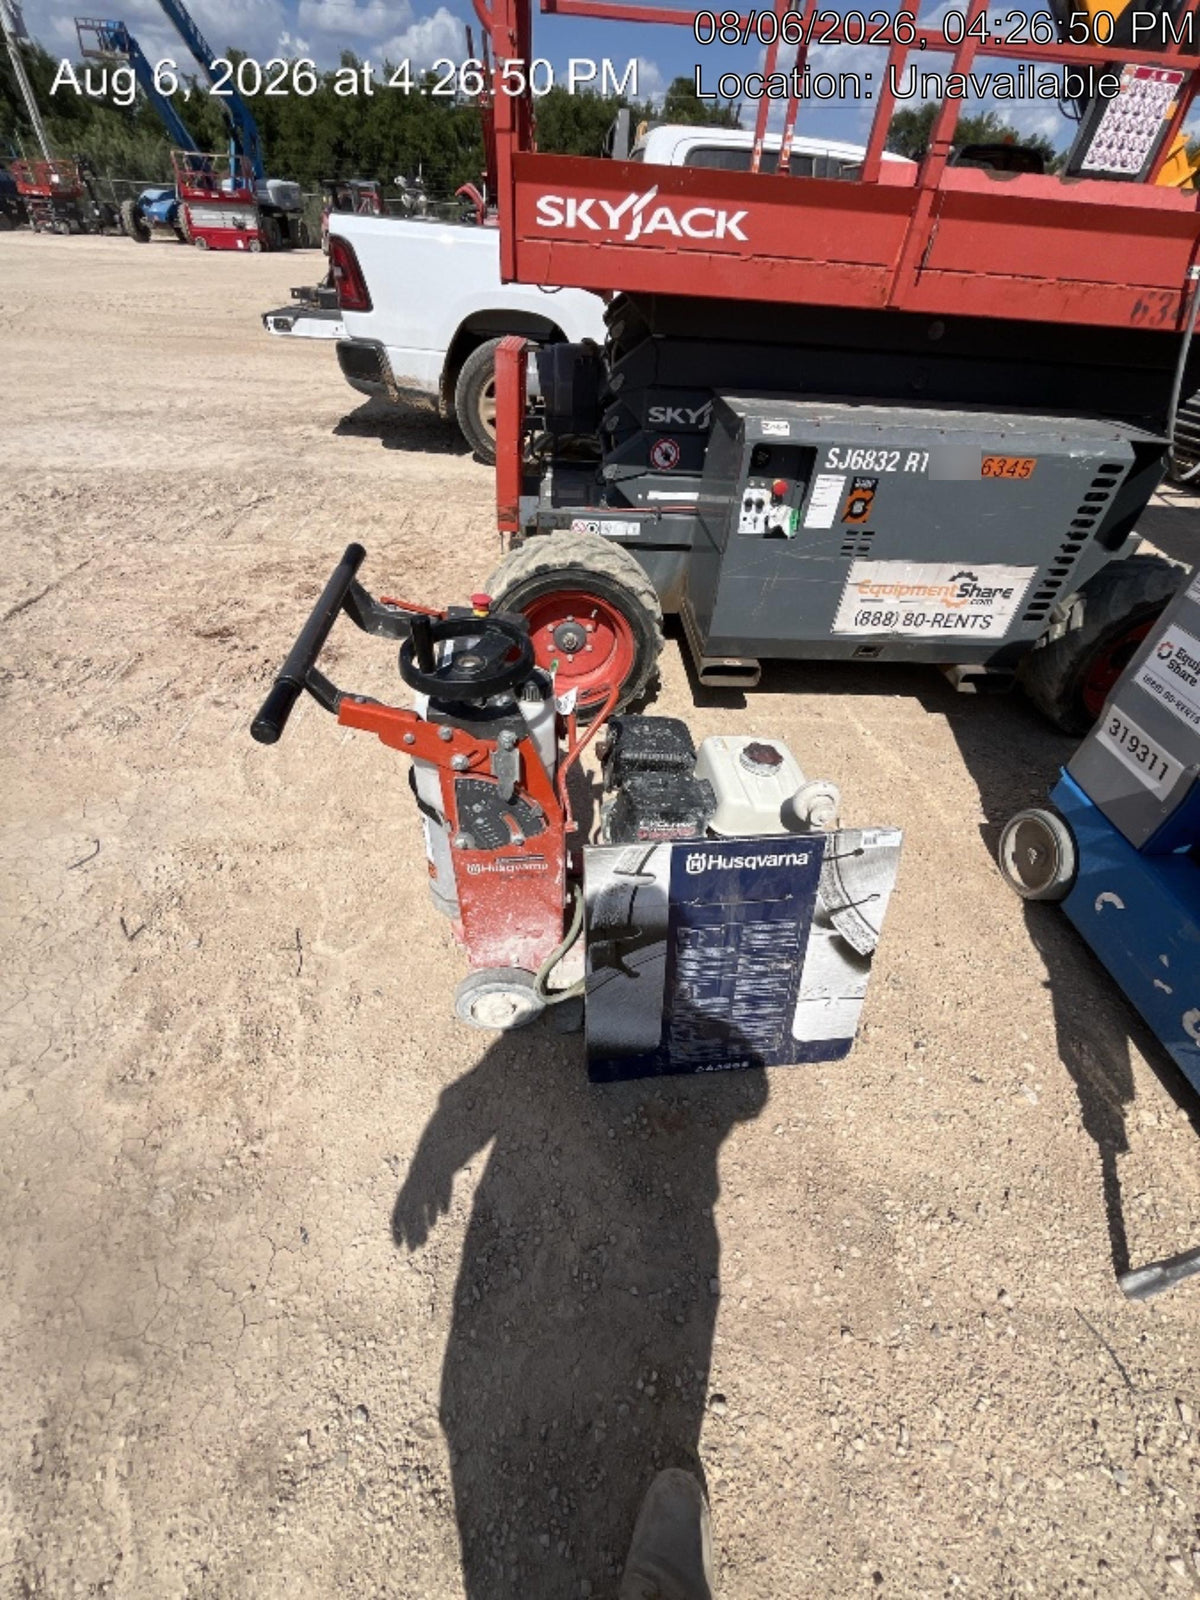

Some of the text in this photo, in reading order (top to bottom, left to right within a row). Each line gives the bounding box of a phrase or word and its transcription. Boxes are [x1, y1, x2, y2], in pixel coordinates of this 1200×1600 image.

[536, 185, 749, 241] SKYJACK
[825, 447, 901, 472] SJ6832
[981, 458, 1034, 478] 6345
[854, 609, 994, 630] (888) 80-RENTS
[1167, 658, 1197, 687] Share
[1108, 717, 1169, 781] 319311
[707, 852, 809, 870] Husqvarna
